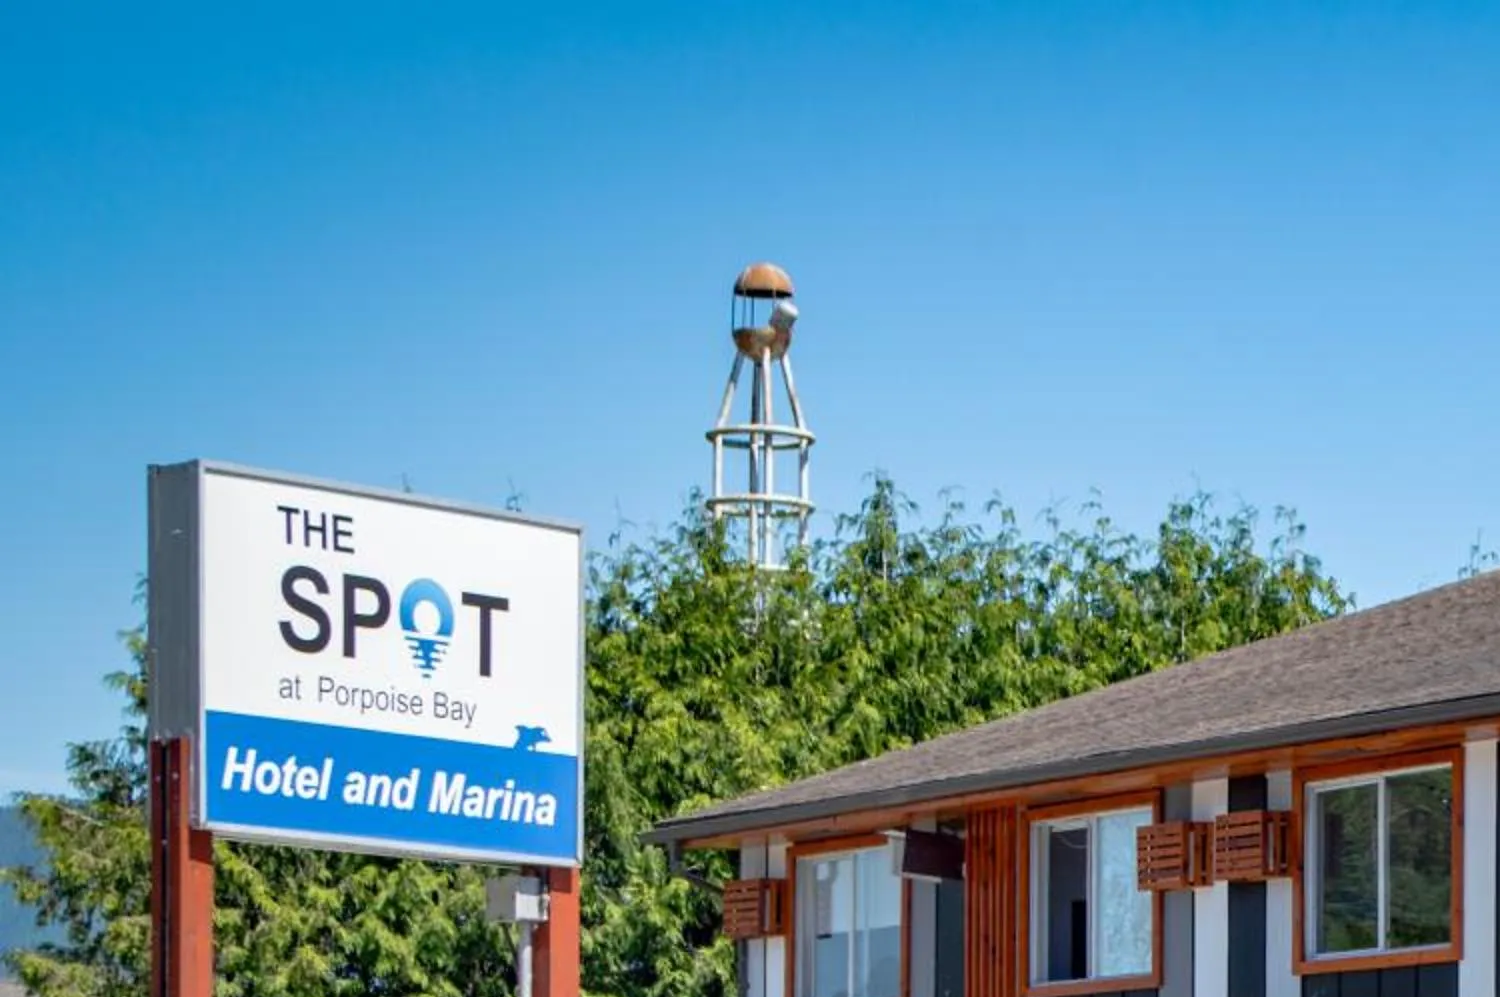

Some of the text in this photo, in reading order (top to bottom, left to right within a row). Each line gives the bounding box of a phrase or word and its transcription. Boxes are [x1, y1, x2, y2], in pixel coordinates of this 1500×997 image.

[277, 505, 355, 554] THE
[278, 565, 510, 679] SPOT
[279, 675, 478, 729] at Porpoise Bay
[221, 746, 558, 827] Hotel and Marina
